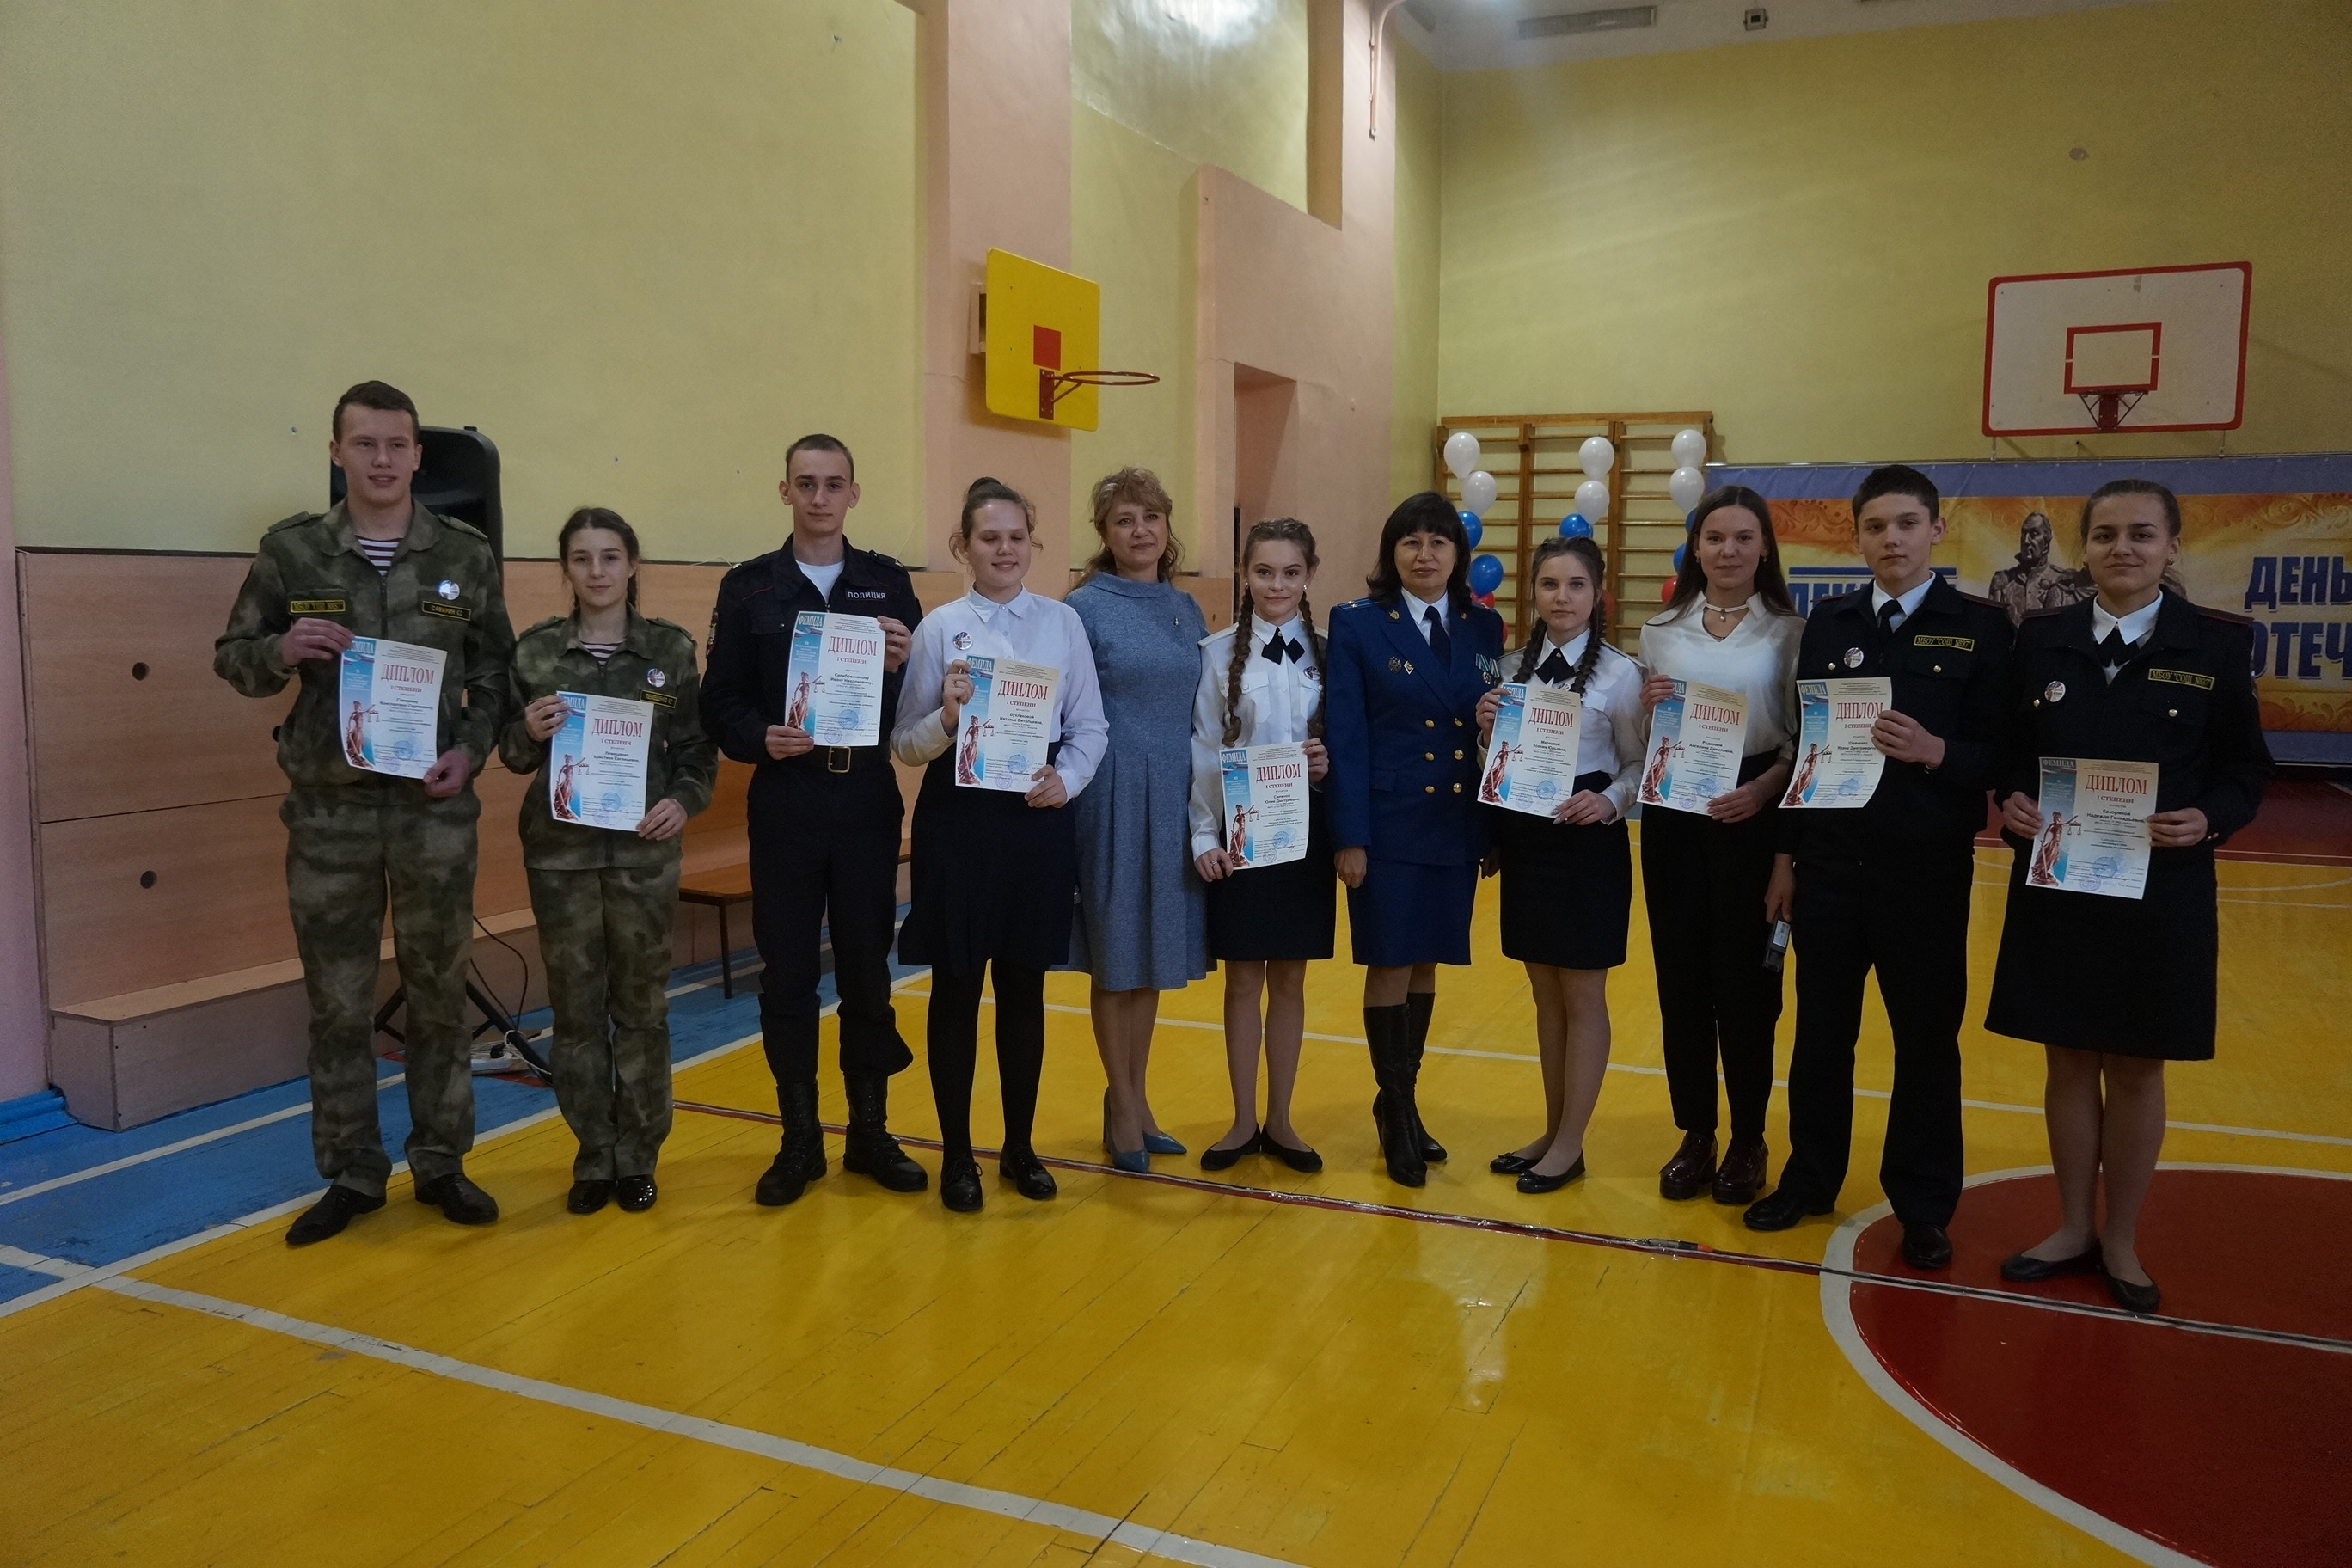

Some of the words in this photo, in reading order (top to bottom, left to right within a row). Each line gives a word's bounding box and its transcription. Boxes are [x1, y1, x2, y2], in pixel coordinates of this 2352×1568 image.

[2244, 556, 2352, 612] ДЕНЬ
[848, 591, 886, 600] ПОЛИЦИЯ
[799, 616, 823, 627] ФЕМИДА
[352, 640, 374, 654] ЕМИДА
[828, 636, 877, 656] ДИПЛОМ
[381, 664, 435, 684] ДИПЛОМ
[998, 680, 1048, 700] ДИПЛОМ
[564, 697, 585, 709] МИДА
[1836, 702, 1884, 720] ДИПЛОМ
[1528, 707, 1574, 727] ДИПЛОМ
[1690, 703, 1740, 726] ДИПЛОМ
[592, 719, 643, 737] ДИПЛОМ
[1222, 752, 1246, 763] ФЕМИДА
[1256, 763, 1301, 783] ДИПЛОМ
[2085, 775, 2147, 795] ДИПЛОМ
